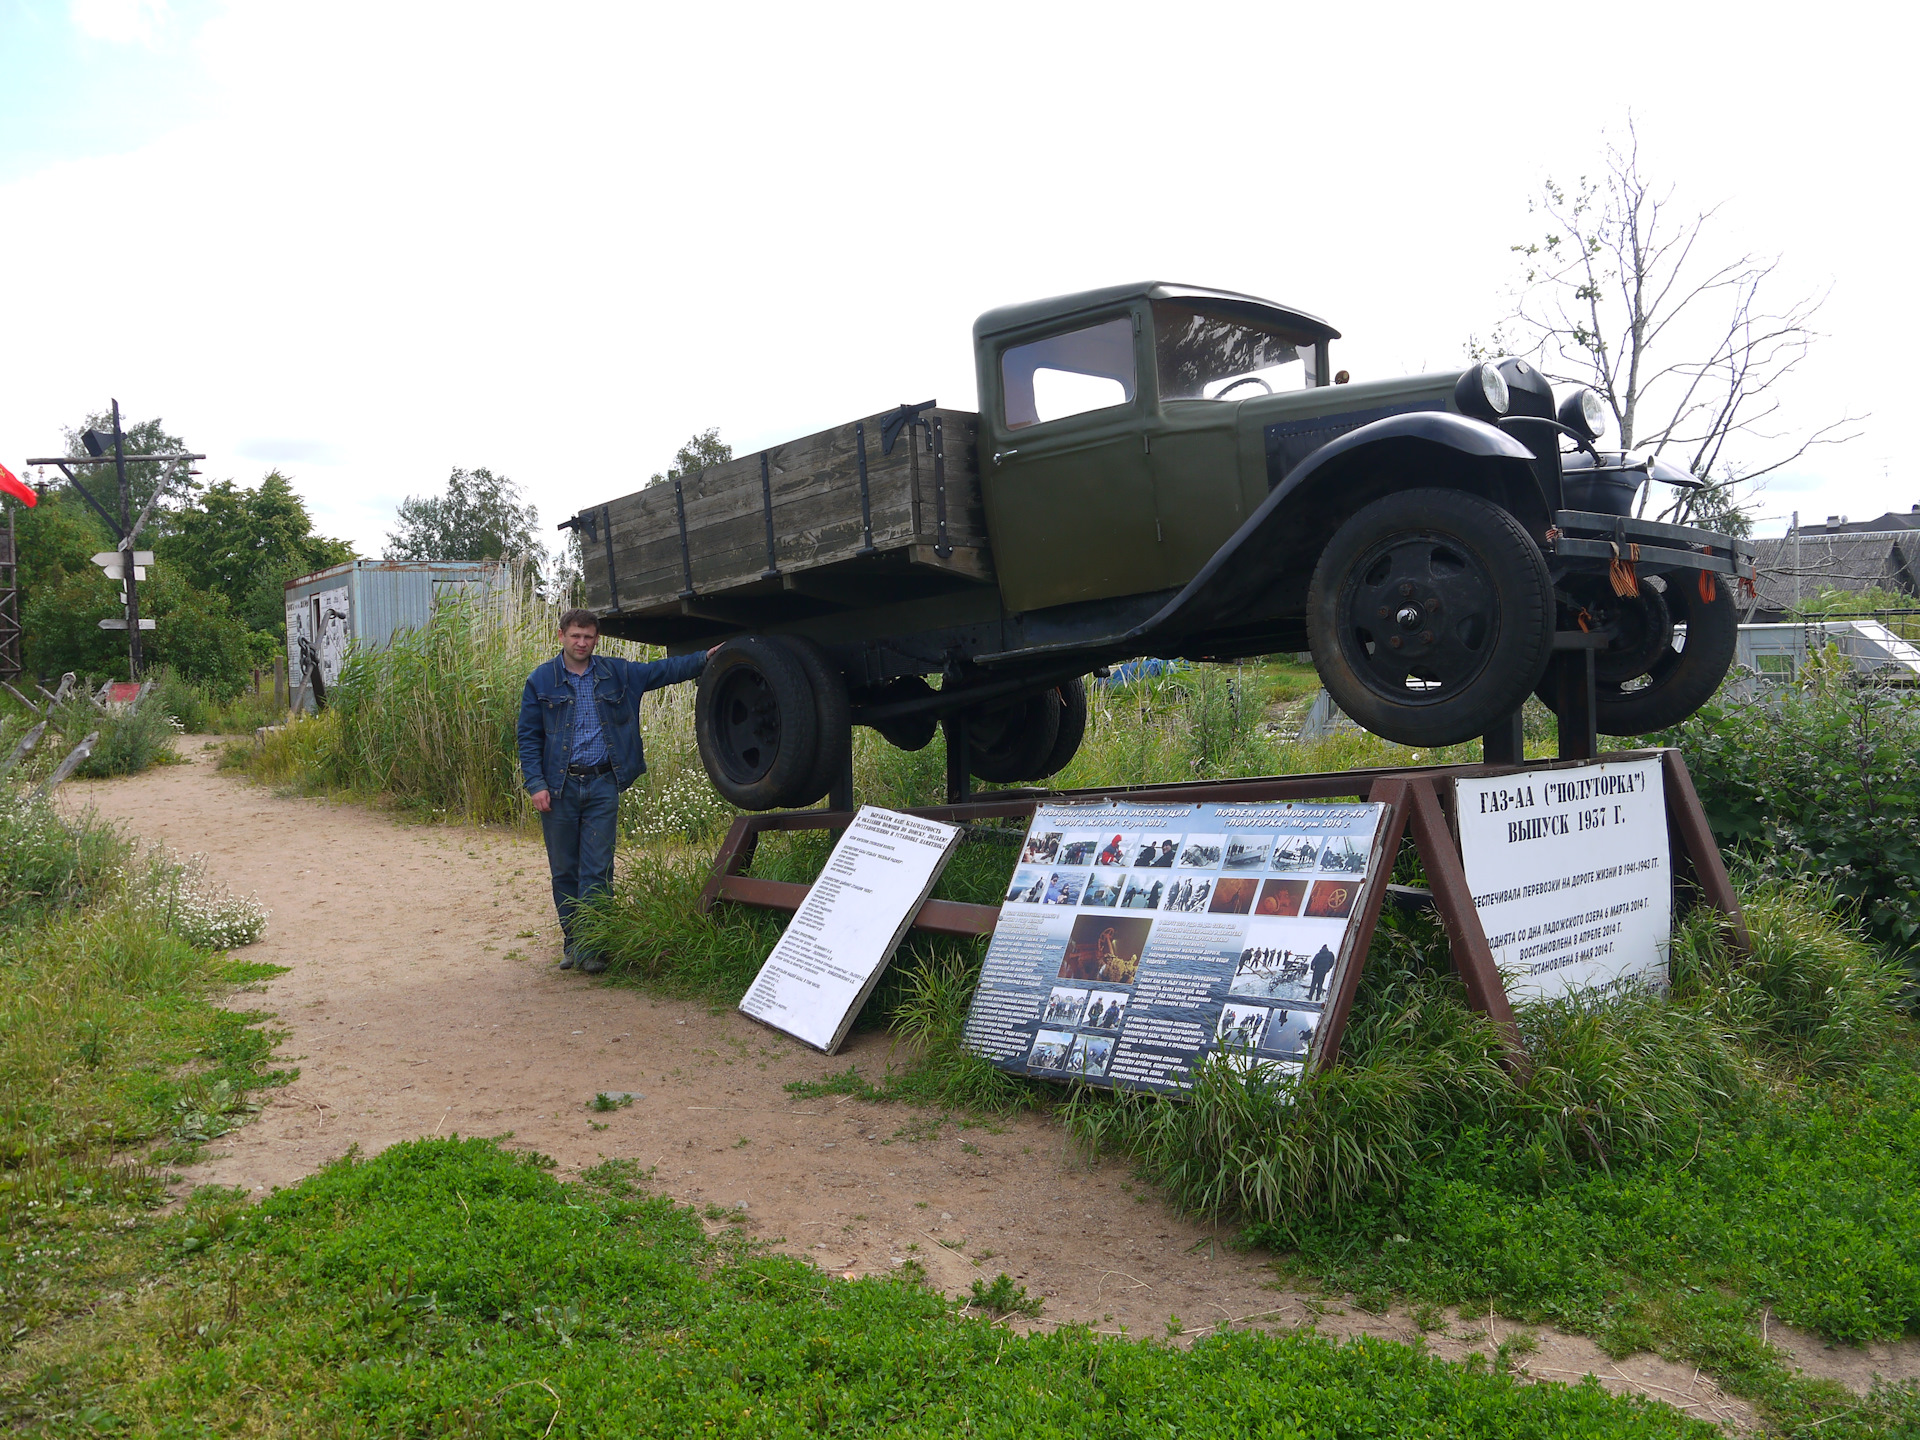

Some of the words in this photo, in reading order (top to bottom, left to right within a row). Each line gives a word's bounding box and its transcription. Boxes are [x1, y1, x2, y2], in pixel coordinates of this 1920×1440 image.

[1480, 786, 1534, 813] ГАЗ-АА
[906, 820, 942, 834] БЛАГОДАРНОСТЬ
[1037, 809, 1127, 818] ПОДВОДНО-ПОИСКОВАЯ
[1129, 809, 1190, 818] ЭКСПЕДИЦИЯ
[1122, 819, 1144, 830] Сезон
[1145, 819, 1160, 827] 2013
[1258, 809, 1325, 818] АВТОМОБИЛЯ
[1326, 809, 1367, 818] ГАЗ-АА
[1290, 819, 1319, 830] Март
[1322, 819, 1342, 828] 2014
[1508, 814, 1569, 843] ВЫПУСК
[1579, 808, 1606, 831] 1937
[1615, 805, 1625, 824] Г.
[1473, 888, 1520, 908] БЕСПЕЧИВАЛА
[1522, 878, 1560, 897] ПЕРЕВОЗКИ
[1562, 877, 1570, 889] НА
[1571, 872, 1594, 888] ДОРОГЕ
[1595, 866, 1617, 882] ЖИЗНИ
[1618, 865, 1622, 876] В
[1624, 858, 1650, 875] 1941-1943
[1518, 930, 1525, 942] СО
[1527, 925, 1541, 940] ДНА
[1543, 914, 1584, 935] ЛАДОЖСКОГО
[1585, 909, 1603, 923] ОЗЕРА
[1605, 908, 1608, 918] 6
[1610, 902, 1630, 917] МАРТА
[1631, 899, 1643, 912] 2014
[1644, 898, 1649, 908] Г.
[1520, 936, 1572, 960] ВОССТАНОВЛЕНА
[1574, 934, 1577, 945] В
[1579, 927, 1601, 942] АПРЕЛЕ
[1603, 924, 1615, 936] 2014
[1617, 922, 1622, 932] Г.
[1530, 954, 1573, 976] УСТАНОВЛЕНА
[1575, 952, 1579, 962] 8
[1580, 948, 1593, 961] МАЯ
[1595, 944, 1608, 957] 2014
[1609, 942, 1614, 952] Г.
